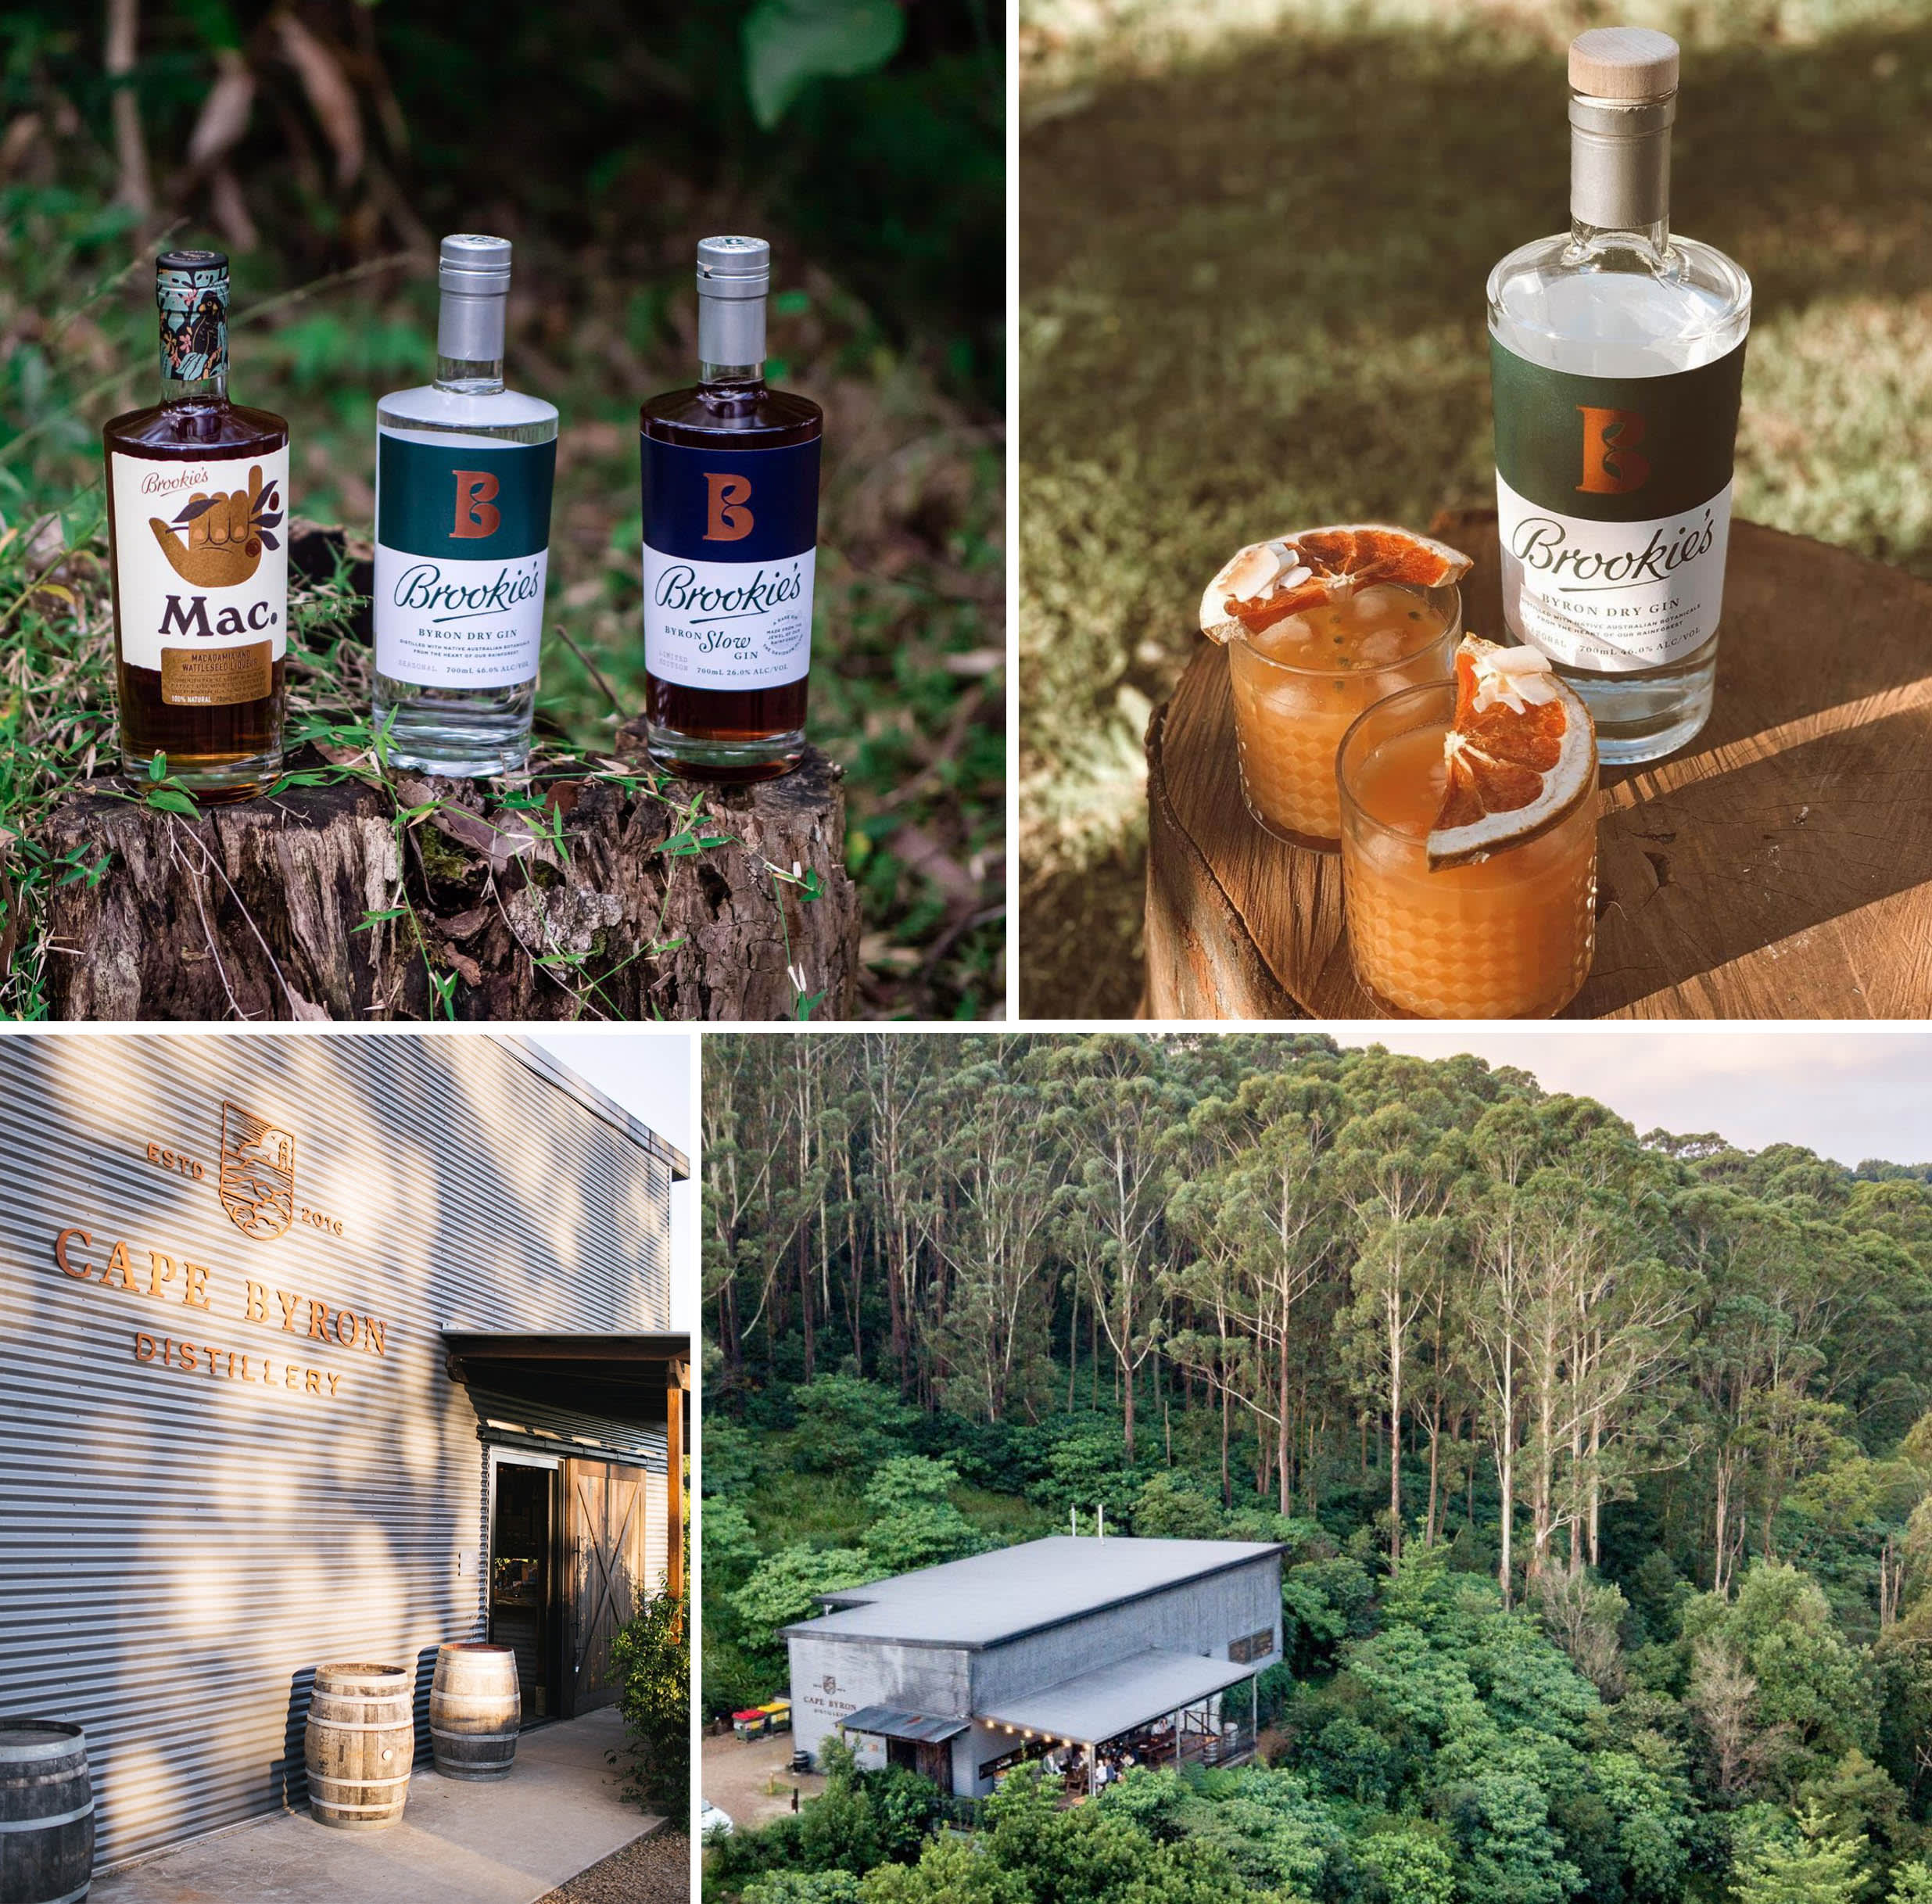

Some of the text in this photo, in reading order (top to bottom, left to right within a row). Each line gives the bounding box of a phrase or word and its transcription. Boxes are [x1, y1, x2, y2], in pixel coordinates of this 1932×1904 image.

[1576, 404, 1651, 495] B
[142, 467, 209, 497] Brookie's
[449, 469, 500, 539] B
[702, 472, 755, 541] B
[1512, 508, 1715, 592] Brookie's
[394, 561, 539, 622] Brookie's
[655, 562, 801, 624] Brookie's
[1542, 593, 1599, 616] BYRON
[1607, 607, 1642, 617] DRY
[1649, 597, 1680, 614] GIN
[158, 595, 278, 636] Mac.
[418, 628, 518, 640] BYRON DRY GIN
[1636, 621, 1684, 636] RAINFOREST
[1660, 603, 1701, 624] BOTANICALS
[665, 626, 758, 660] BYRON Slow GIN
[1657, 626, 1701, 651] ALC/VOL
[697, 667, 724, 676] 700mL
[753, 663, 789, 675] ALC/VOL
[146, 1142, 345, 1236] ESTD 2016
[54, 1227, 389, 1357] CAPE BYRON
[134, 1331, 342, 1397] DISTILLERY
[803, 1695, 857, 1711] CAPE BYRON
